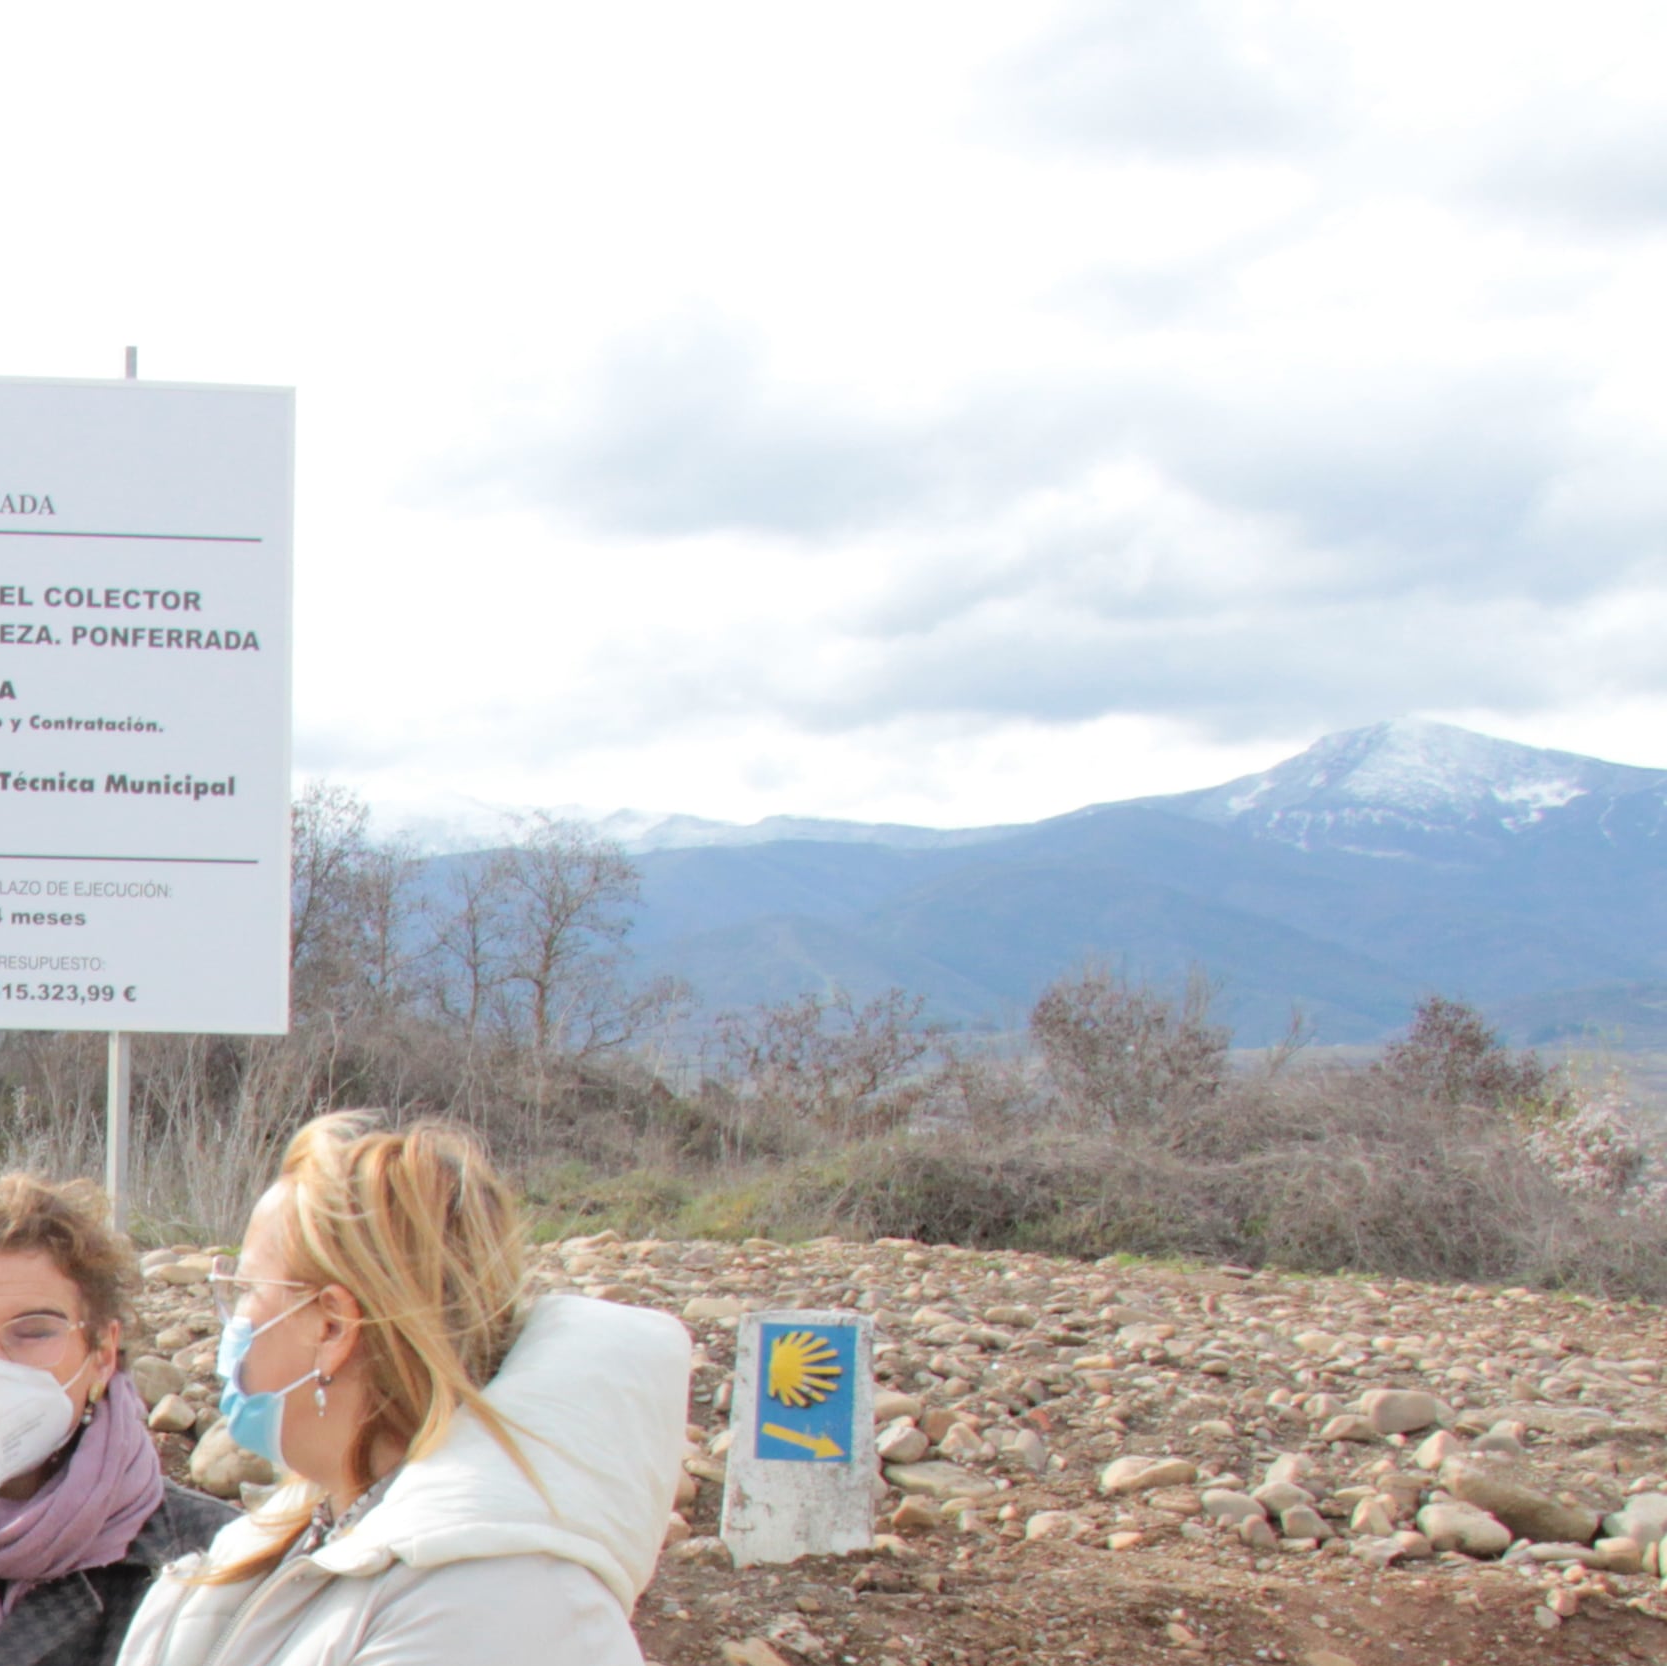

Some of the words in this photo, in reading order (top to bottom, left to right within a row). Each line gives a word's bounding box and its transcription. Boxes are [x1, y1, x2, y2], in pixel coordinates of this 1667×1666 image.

[44, 587, 201, 611] COLECTOR
[72, 626, 259, 651] PONFERRADA
[10, 718, 22, 733] y
[29, 715, 163, 732] Contratación.
[105, 774, 235, 801] Municipal
[46, 881, 68, 896] DE
[74, 880, 171, 898] EJECUCIÓN:
[11, 912, 86, 926] meses
[123, 986, 136, 1002] €
